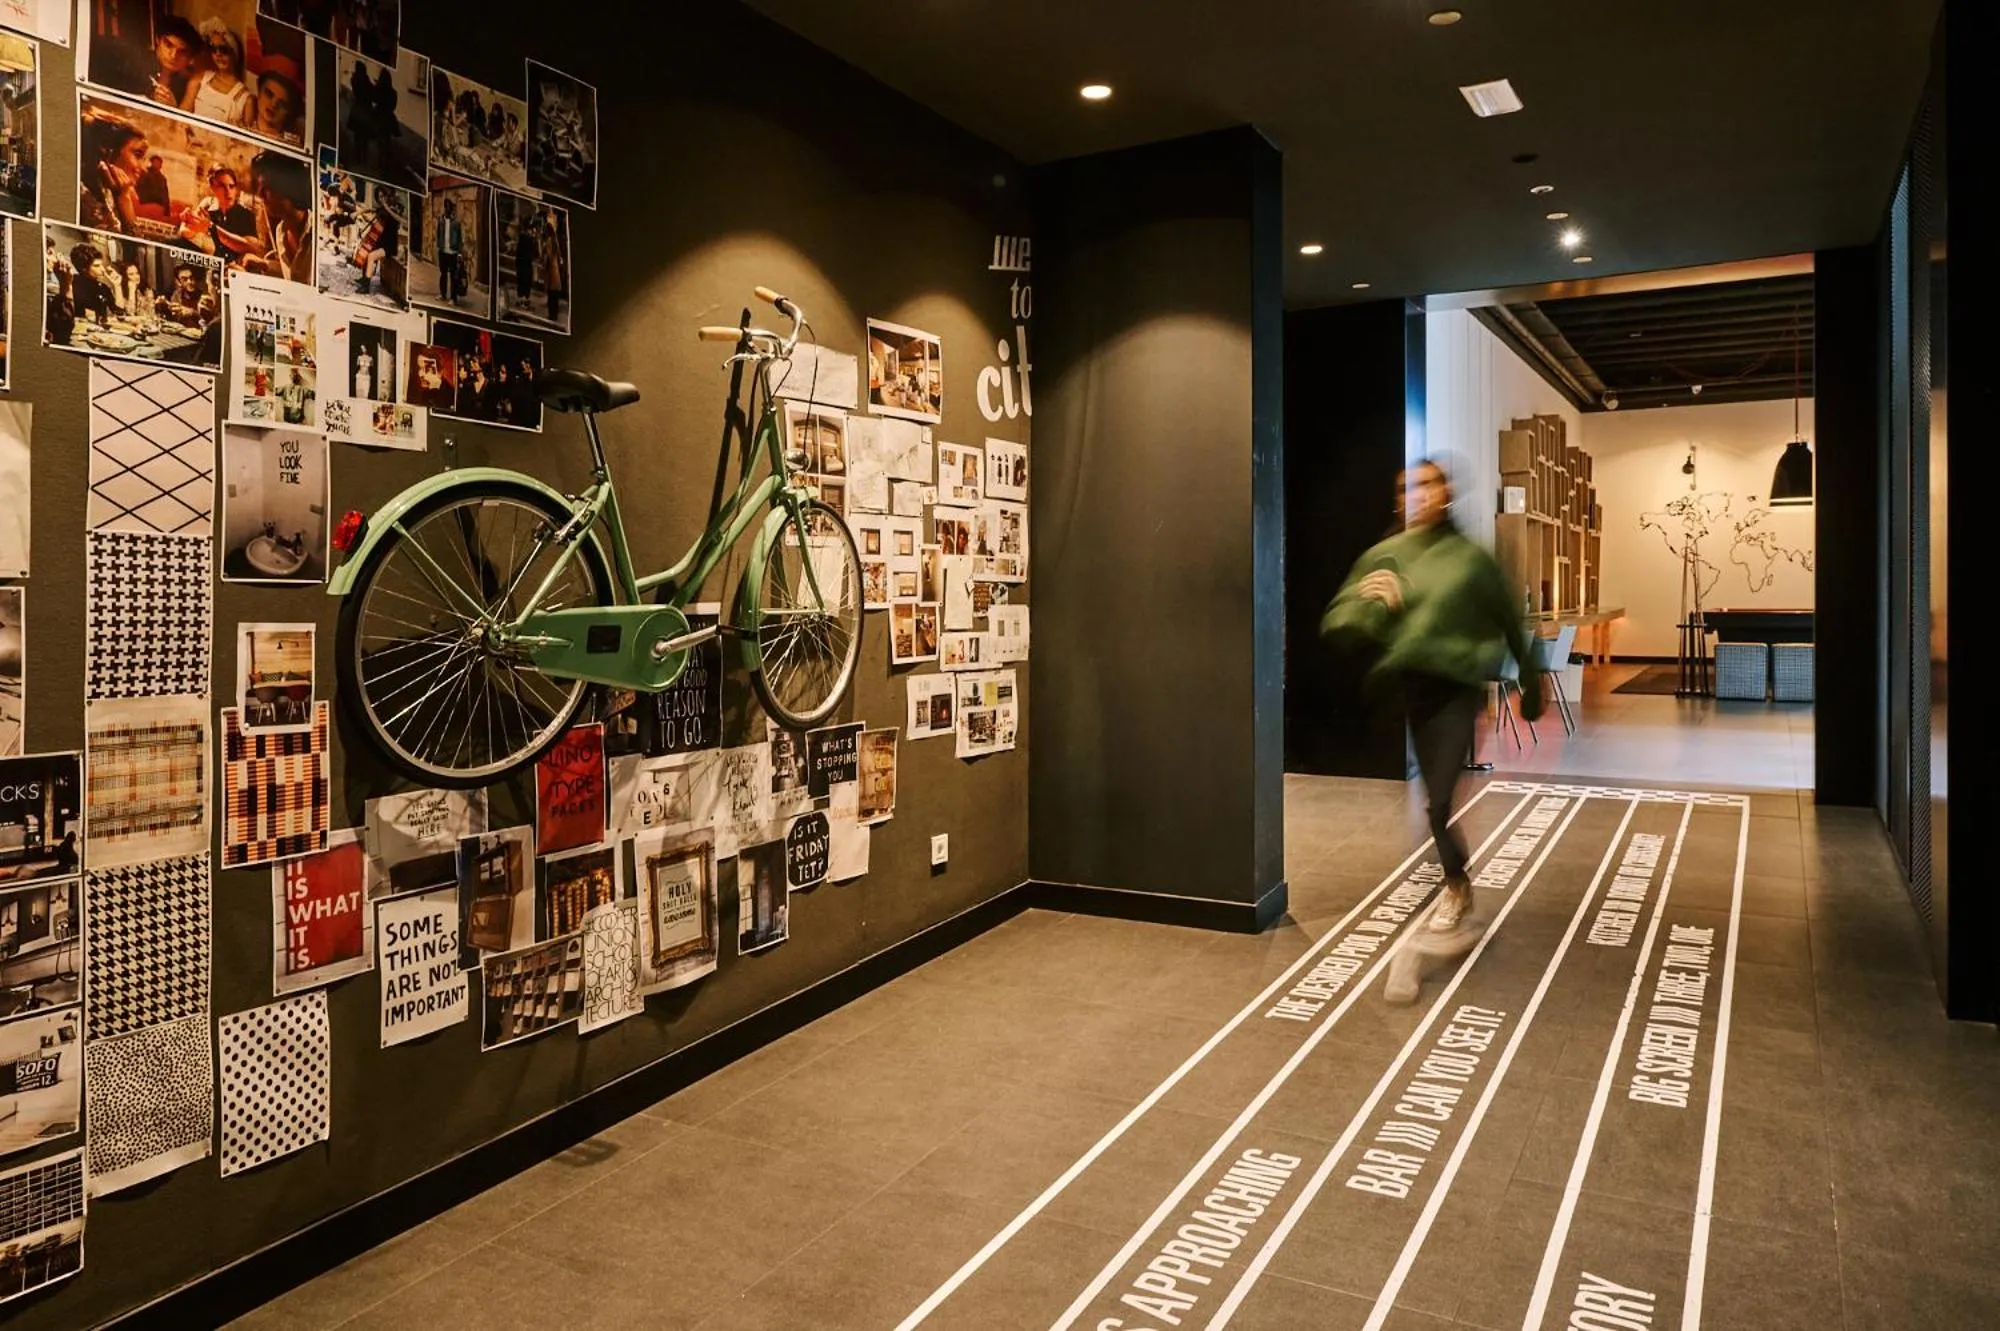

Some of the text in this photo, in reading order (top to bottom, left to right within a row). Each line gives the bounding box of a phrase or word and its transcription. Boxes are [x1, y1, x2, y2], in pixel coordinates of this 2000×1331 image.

[169, 248, 220, 268] DREAMERS
[1010, 277, 1031, 319] to
[280, 440, 300, 453] YOU
[279, 454, 302, 470] LOOK
[280, 471, 300, 485] FINE
[657, 688, 706, 719] REASON
[660, 720, 675, 749] TO
[822, 737, 853, 753] WHAT'S
[549, 744, 593, 768] LINO
[817, 751, 858, 769] STOPPING
[550, 775, 596, 798] TYPE
[828, 770, 844, 781] YOU
[794, 820, 818, 840] IS IT
[788, 834, 829, 865] FRIDAY
[798, 858, 824, 882] YET?
[287, 877, 309, 901] IS
[668, 881, 692, 899] HOLY
[288, 891, 361, 924] WHAT
[288, 926, 309, 949] IT
[385, 913, 443, 947] SOME
[1668, 924, 1714, 945] ONE
[385, 930, 457, 972] THINGS
[1331, 933, 1388, 959] POOL
[288, 948, 316, 971] IS.
[386, 959, 457, 1002] ARE NOT
[1289, 956, 1363, 1000] DESIRED
[1653, 969, 1711, 1006] THREE,
[385, 985, 466, 1028] IMPORTANT
[1264, 996, 1326, 1022] THE
[1635, 1022, 1699, 1078] SCREEN
[1345, 1004, 1506, 1199] BAR CAN YOU SEE IT?
[1628, 1075, 1690, 1108] BIG
[1120, 1147, 1302, 1326] APPROACHING
